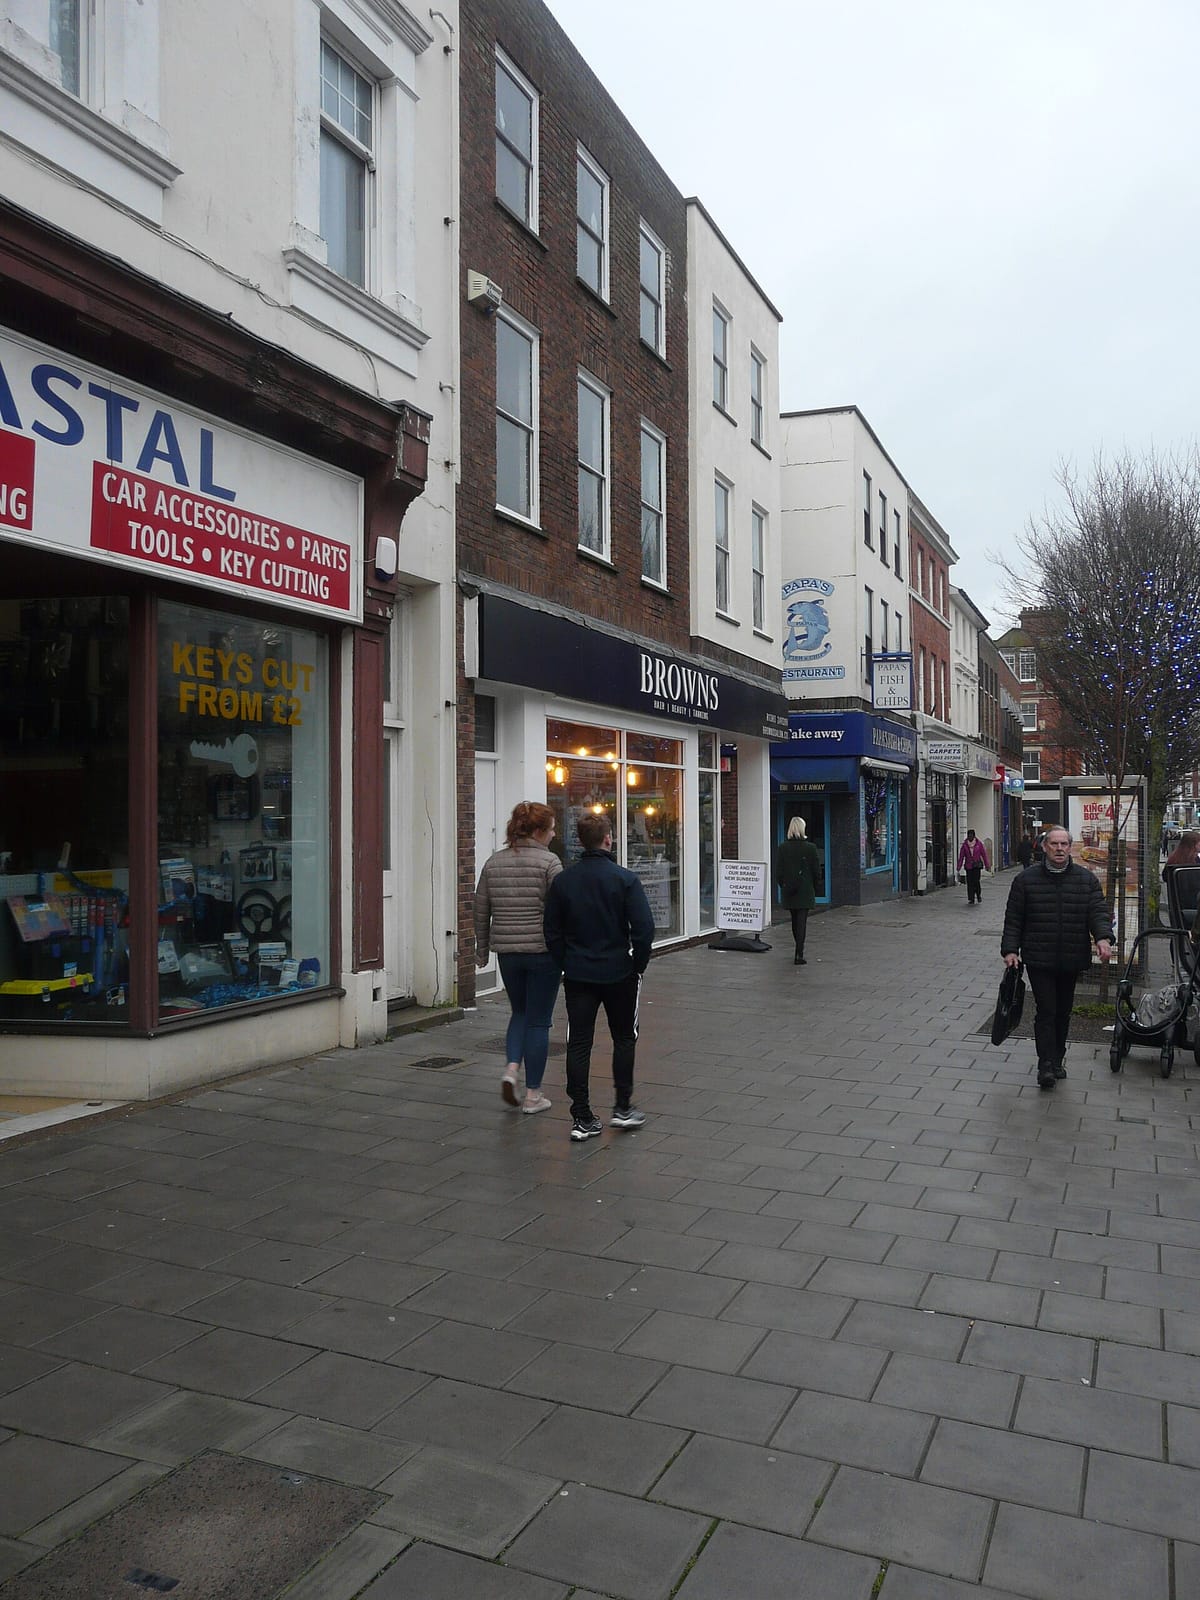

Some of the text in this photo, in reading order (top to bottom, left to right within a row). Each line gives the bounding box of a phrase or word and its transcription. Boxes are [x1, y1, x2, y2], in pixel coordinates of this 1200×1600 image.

[102, 472, 348, 572] CAR ACCESSORIES PARTS
[128, 520, 330, 600] TOOLS KEY CUTTING
[783, 579, 830, 594] PAPA'S
[172, 641, 316, 692] KEYS CUT
[878, 663, 907, 671] PAPA'S
[782, 667, 842, 679] ESTAURANT
[639, 653, 719, 711] BROWNS
[880, 674, 904, 684] FISH
[887, 686, 896, 695] &
[179, 681, 303, 726] FROM £2
[876, 695, 909, 706] CHIPS
[814, 730, 845, 741] away
[1083, 804, 1103, 812] KING
[1083, 812, 1100, 821] BOX
